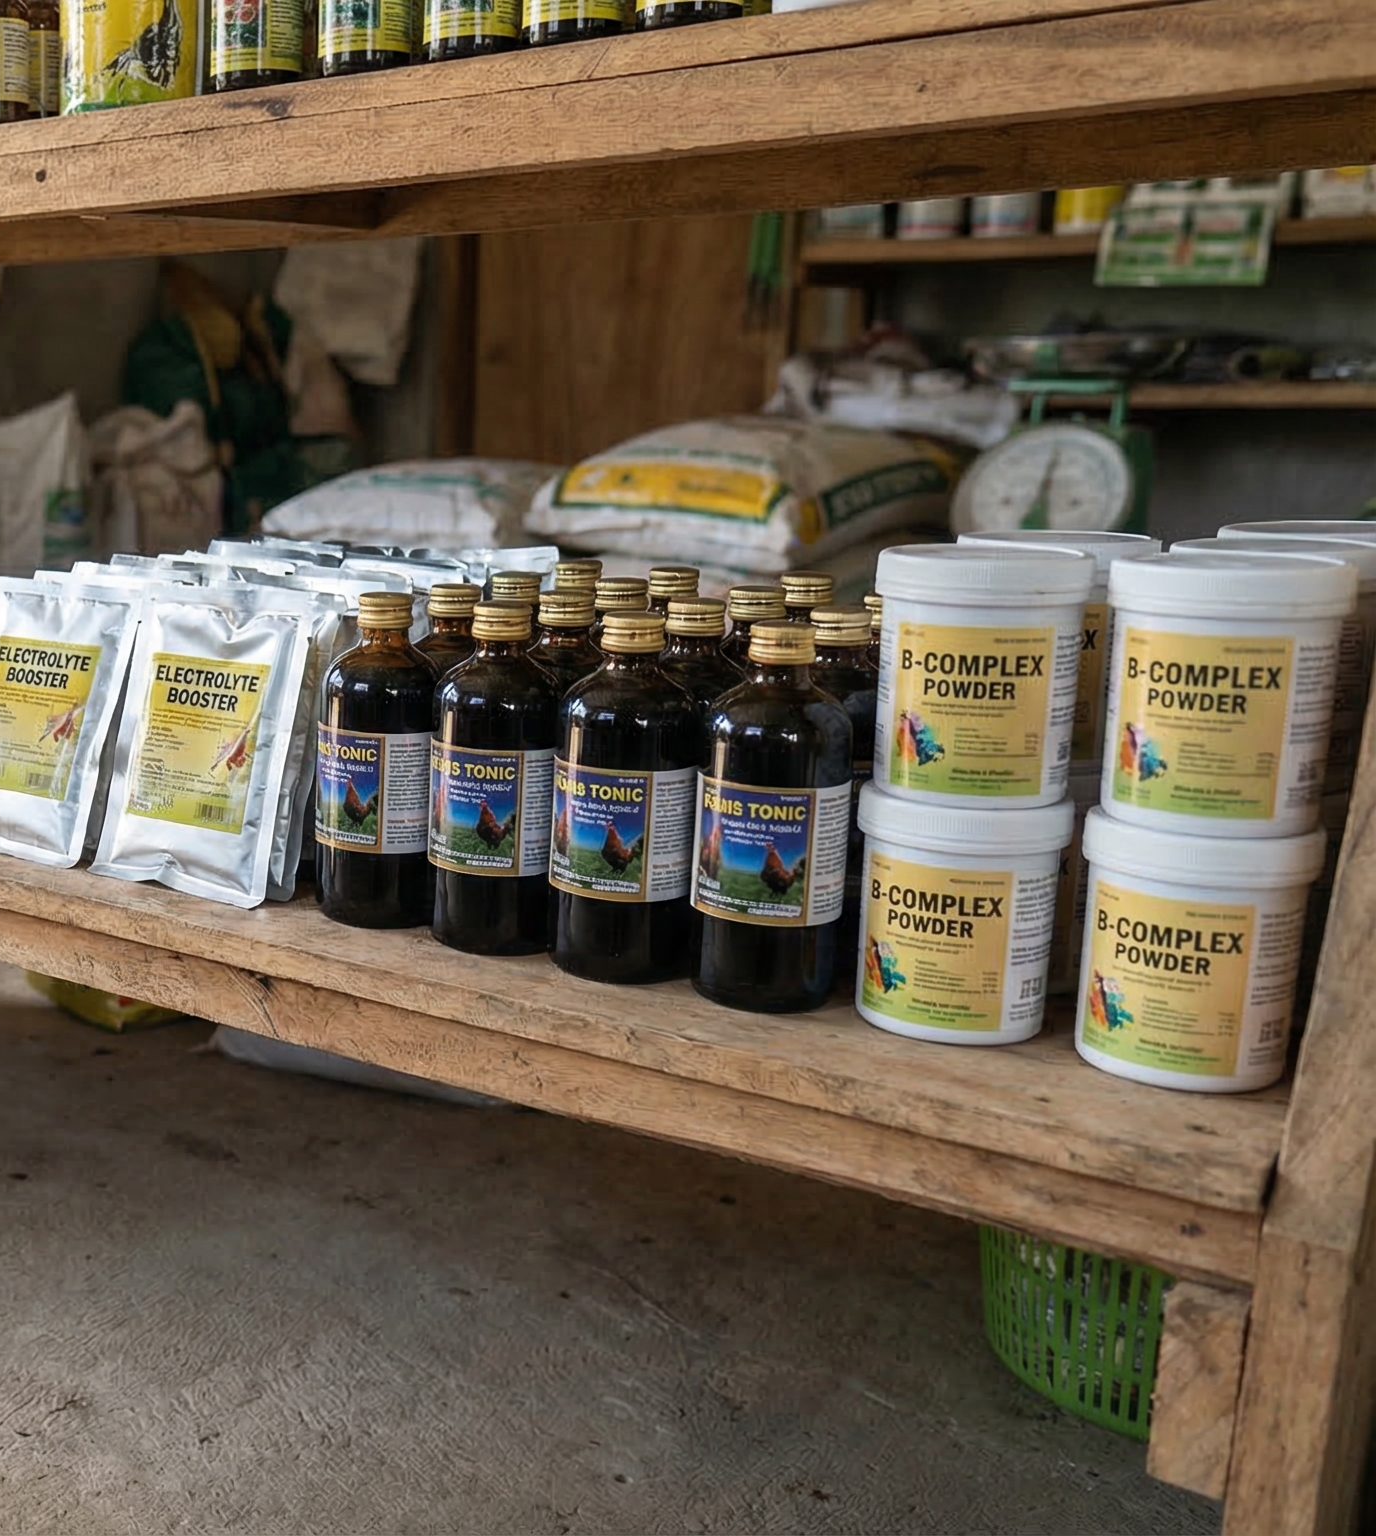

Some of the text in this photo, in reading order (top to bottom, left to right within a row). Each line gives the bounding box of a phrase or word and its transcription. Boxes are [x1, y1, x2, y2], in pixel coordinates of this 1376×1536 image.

[901, 649, 1045, 677] B-COMPLEX
[1127, 657, 1282, 690] B-COMPLEX
[5, 666, 69, 689] BOOSTER
[155, 664, 260, 693] ELECTROLYTE
[923, 678, 1016, 701] POWDER
[167, 687, 238, 713] BOOSTER
[1147, 688, 1247, 714] POWDER
[335, 745, 378, 762] TONIC
[464, 763, 516, 780] TONIC
[589, 784, 644, 802] TONIC
[748, 802, 807, 821] TONIC
[871, 879, 1004, 918] B-COMPLEX
[887, 908, 974, 939] POWDER
[1098, 909, 1244, 955] B-COMPLEX
[1115, 942, 1211, 976] POWDER
